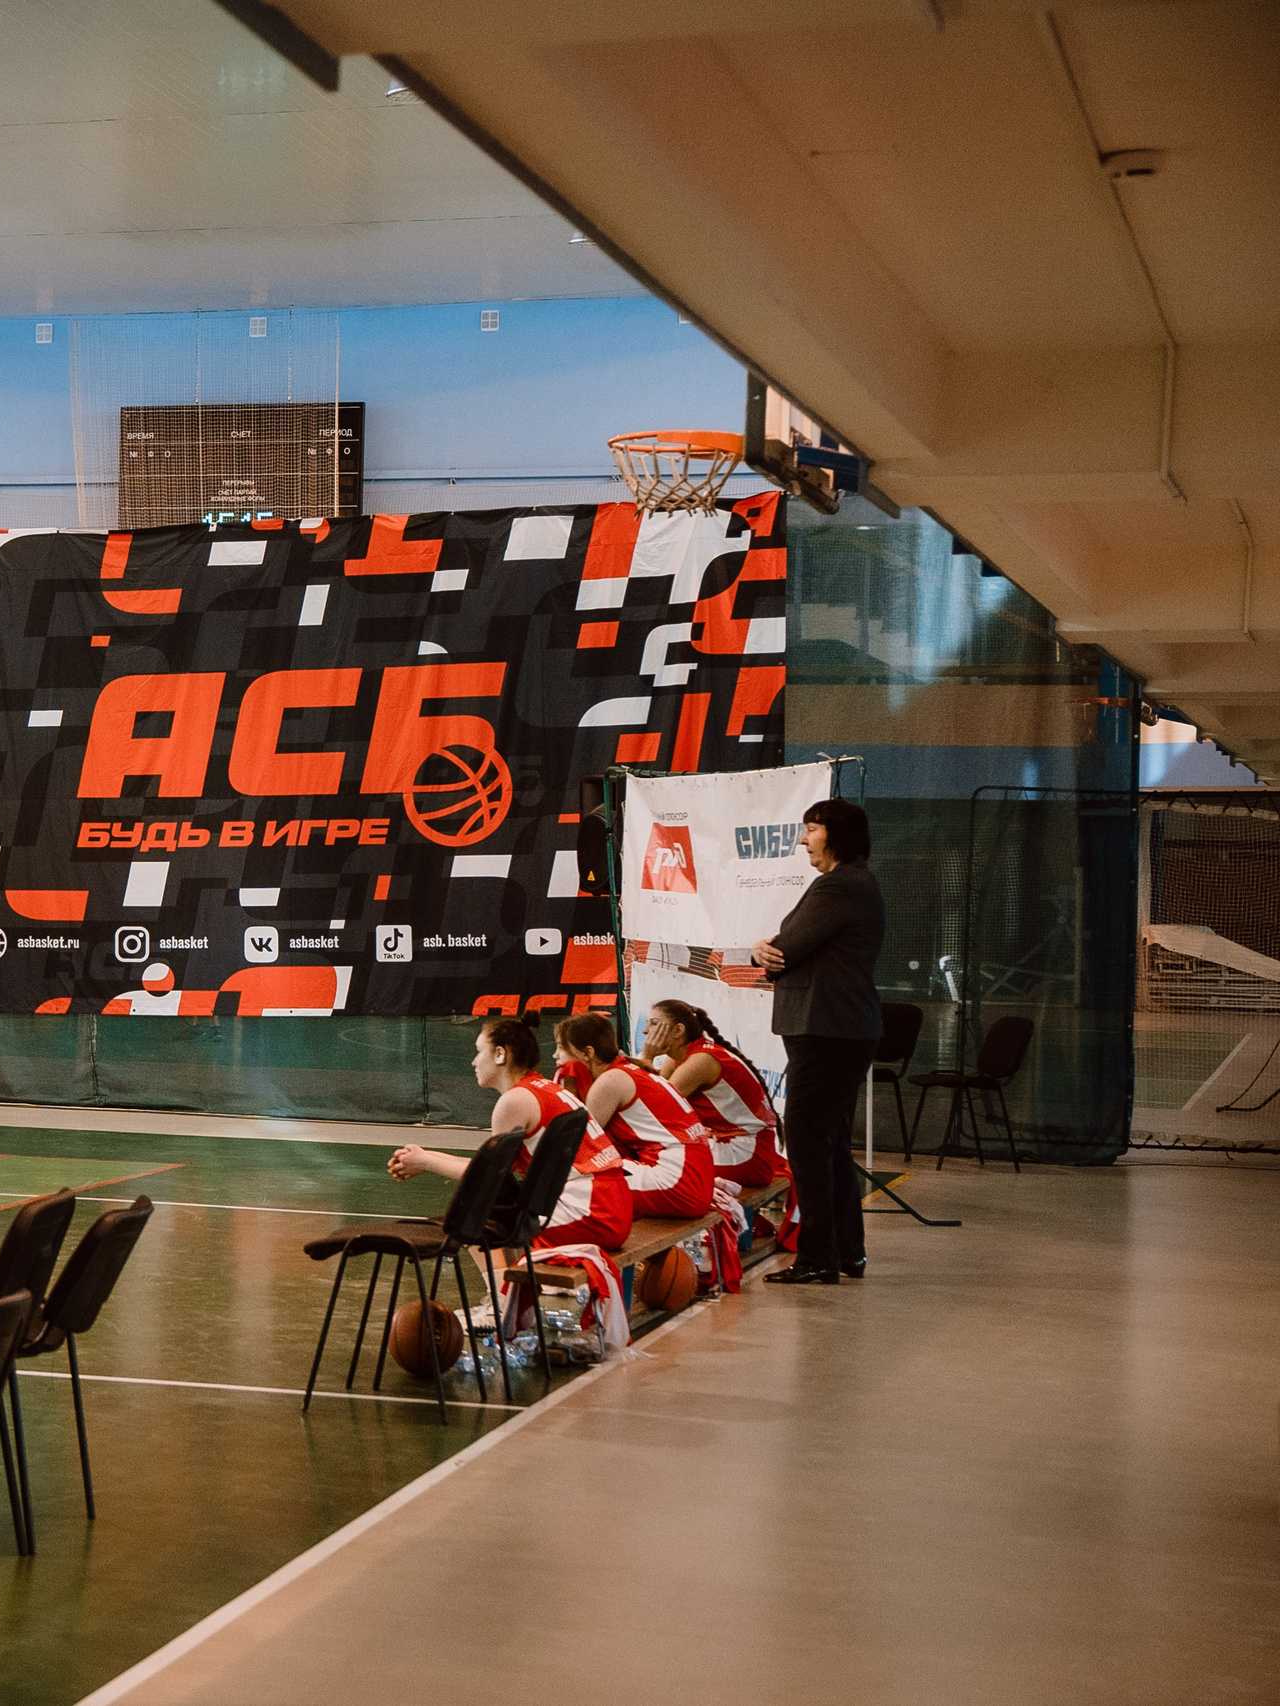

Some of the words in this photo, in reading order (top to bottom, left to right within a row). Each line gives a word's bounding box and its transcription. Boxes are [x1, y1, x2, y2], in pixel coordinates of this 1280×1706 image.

[127, 432, 155, 440] ВРЕМЯ
[230, 430, 252, 438] СЧЕТ
[319, 428, 352, 437] ПЕРИОД
[77, 662, 510, 800] АСБ
[77, 821, 211, 852] БУДЬ
[219, 821, 256, 847] В
[262, 818, 391, 847] ИГРЕ
[17, 937, 80, 949] asbasket.ru
[159, 936, 209, 950] asbasket
[289, 935, 340, 949] asbasket
[573, 931, 615, 946] asbask
